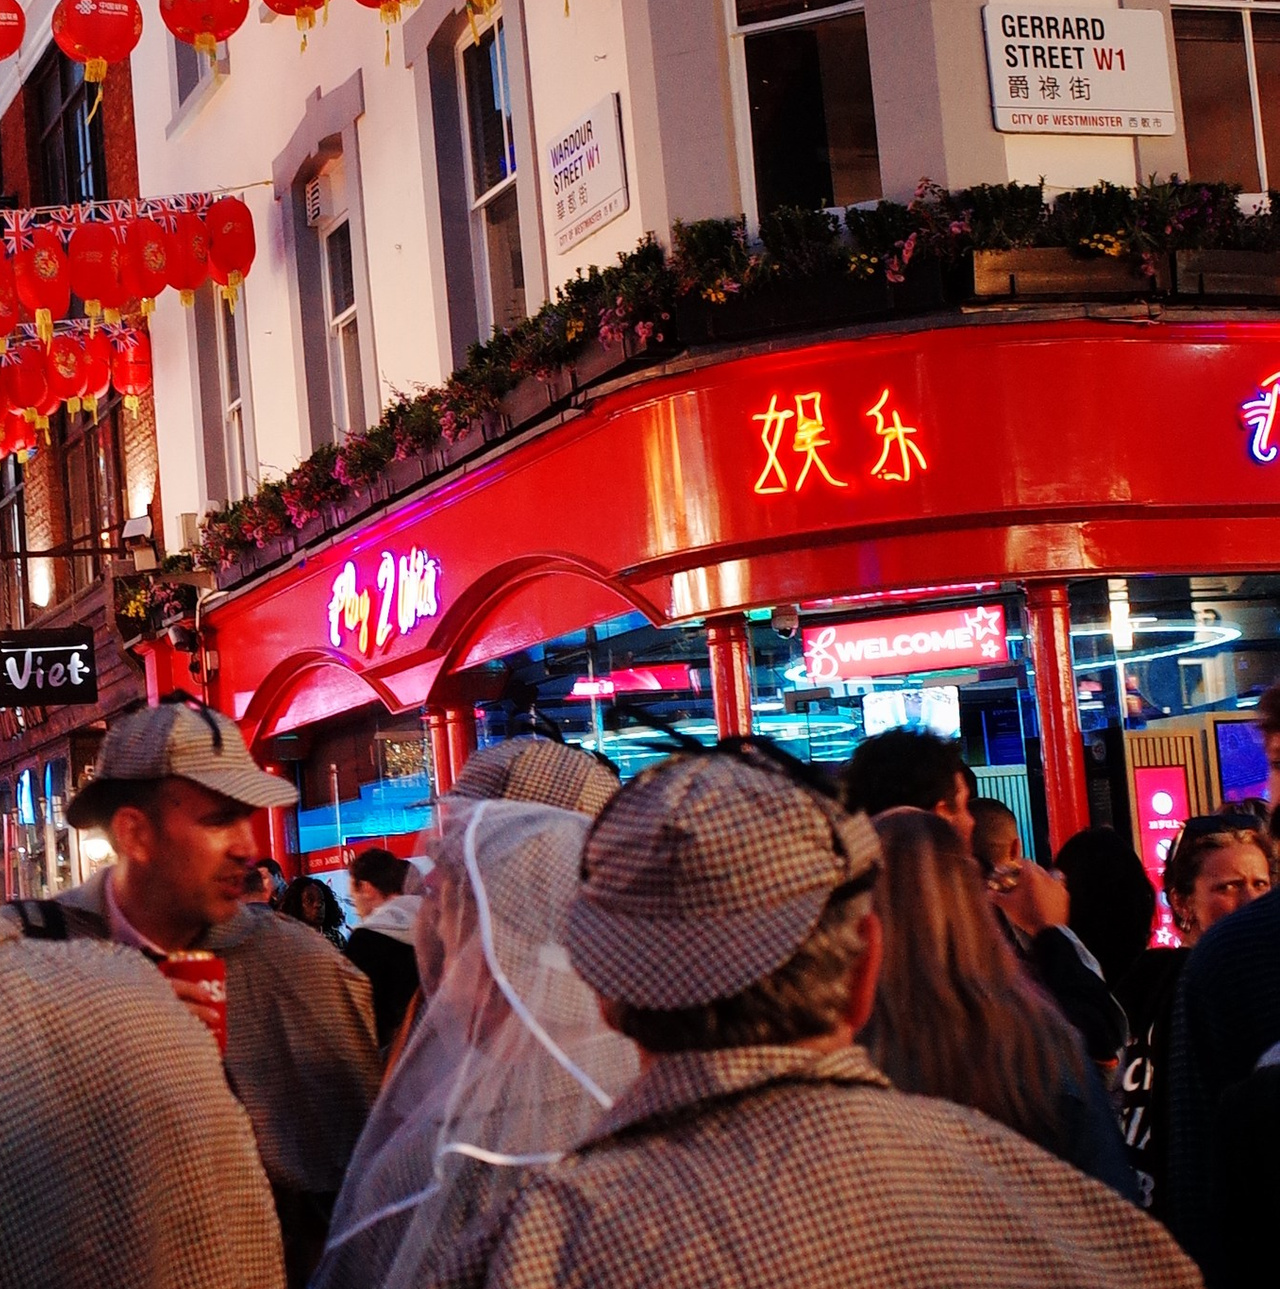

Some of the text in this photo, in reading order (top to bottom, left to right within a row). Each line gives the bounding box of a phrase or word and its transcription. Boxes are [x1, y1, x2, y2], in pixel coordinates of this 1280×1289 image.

[1001, 14, 1106, 41] GERRARD
[1004, 44, 1126, 71] STREET W1
[1011, 113, 1034, 125] CITY
[1037, 114, 1049, 126] OF
[1053, 114, 1123, 128] WESTMINSTER
[550, 119, 594, 169] WARDOUR
[553, 142, 602, 196] STREET W1
[375, 550, 396, 647] 2
[835, 626, 974, 663] WELCOME
[5, 648, 91, 690] Viet
